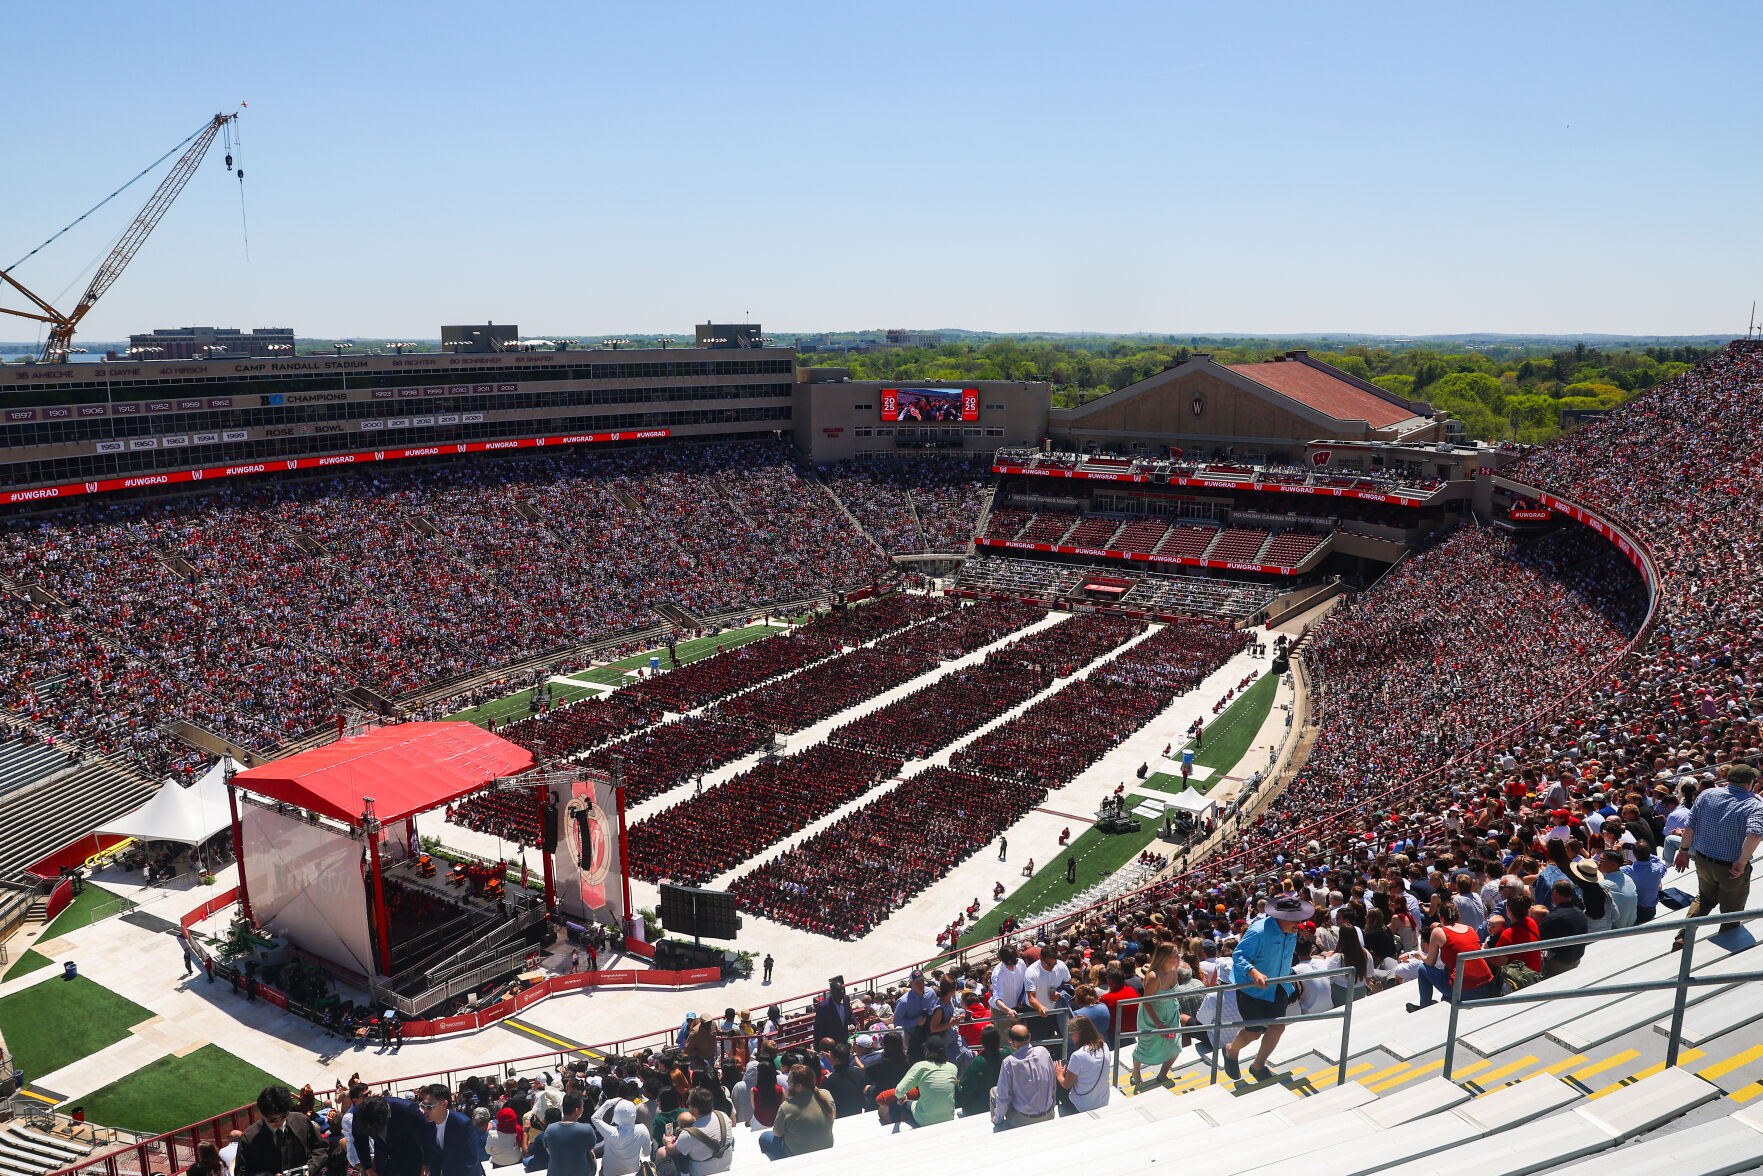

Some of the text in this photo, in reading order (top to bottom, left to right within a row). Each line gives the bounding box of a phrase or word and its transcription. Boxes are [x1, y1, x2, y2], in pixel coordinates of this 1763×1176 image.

[110, 368, 141, 376] DAYNE
[235, 364, 266, 372] CAMP
[271, 362, 320, 370] RANDALL
[32, 370, 74, 379] AMECHE
[287, 393, 347, 403] CHAMPIONS
[266, 428, 294, 437] ROSE
[1312, 450, 1331, 467] W
[10, 488, 59, 501] #UWGRAD
[125, 476, 168, 486] #UWGRAD
[226, 465, 265, 475] #UWGRAD
[319, 456, 354, 464] #UWGRAD
[405, 448, 438, 456] #UWGRAD
[486, 441, 518, 450] #UWGRAD
[563, 435, 593, 443] #UWGRAD
[1358, 492, 1386, 501] #UWGRAD
[1149, 555, 1182, 563] #UWGRAD
[1227, 563, 1262, 571] #UWGRAD
